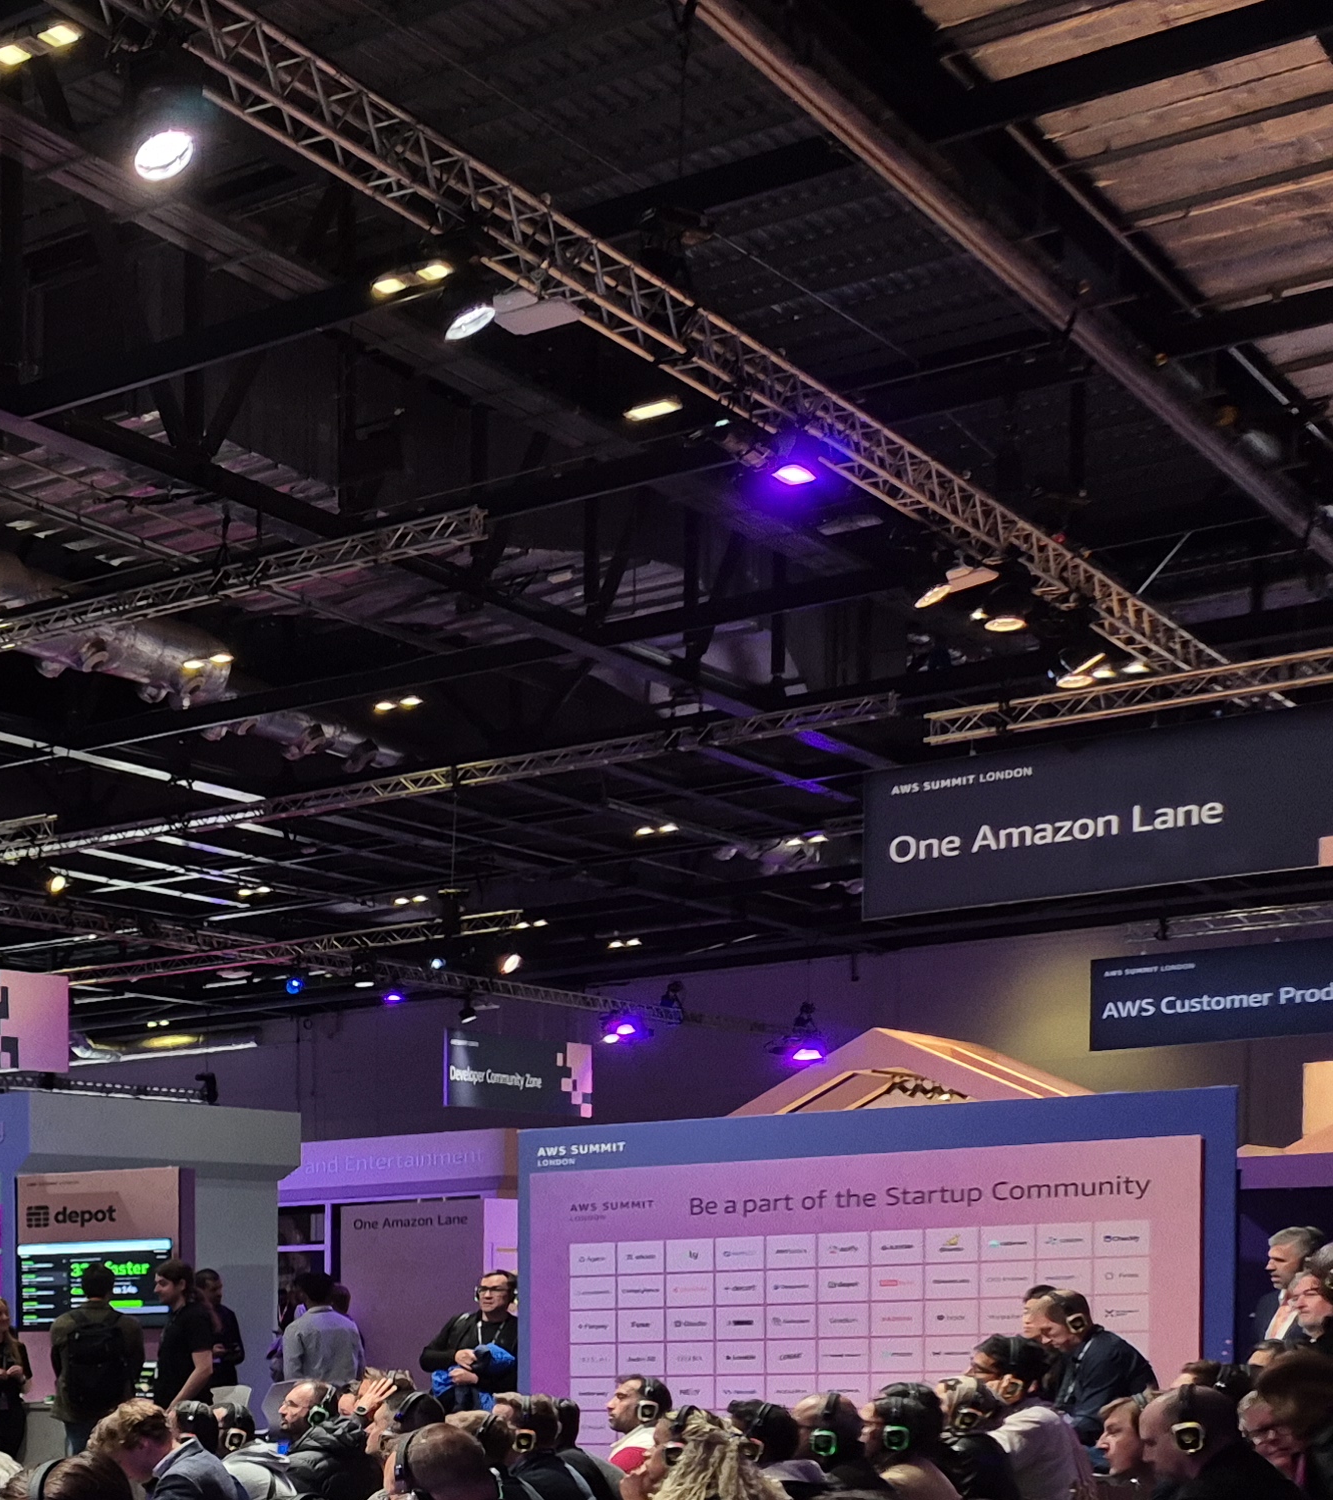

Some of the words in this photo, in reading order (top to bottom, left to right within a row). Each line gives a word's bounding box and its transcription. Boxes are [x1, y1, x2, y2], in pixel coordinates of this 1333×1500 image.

[890, 782, 920, 796] AWS
[922, 774, 976, 792] SUMMIT
[979, 766, 1033, 783] LONDON
[888, 834, 962, 864] One
[971, 813, 1120, 854] Amazon
[1132, 800, 1225, 833] Lane
[1103, 968, 1123, 978] AWS
[1124, 965, 1159, 976] SUMMIT
[1160, 962, 1196, 973] LONDON
[1101, 998, 1156, 1019] AWS
[1160, 991, 1274, 1015] Customer
[449, 1065, 485, 1086] Developer
[486, 1068, 525, 1090] Community
[525, 1073, 542, 1089] Zone
[537, 1146, 567, 1157] AWS
[570, 1141, 626, 1155] SUMMIT
[304, 1156, 339, 1175] and
[345, 1148, 482, 1172] Entertainment
[537, 1157, 576, 1167] LONDON
[569, 1202, 597, 1212] AWS
[602, 1200, 654, 1211] SUMMIT
[689, 1197, 718, 1216] Be
[723, 1199, 737, 1214] a
[742, 1194, 794, 1218] part
[801, 1189, 828, 1211] of
[834, 1188, 877, 1209] the
[884, 1184, 983, 1207] Startup
[991, 1175, 1152, 1201] Community
[53, 1205, 117, 1228] depot
[353, 1217, 379, 1231] One
[383, 1215, 433, 1229] Amazon
[437, 1214, 468, 1226] Lane
